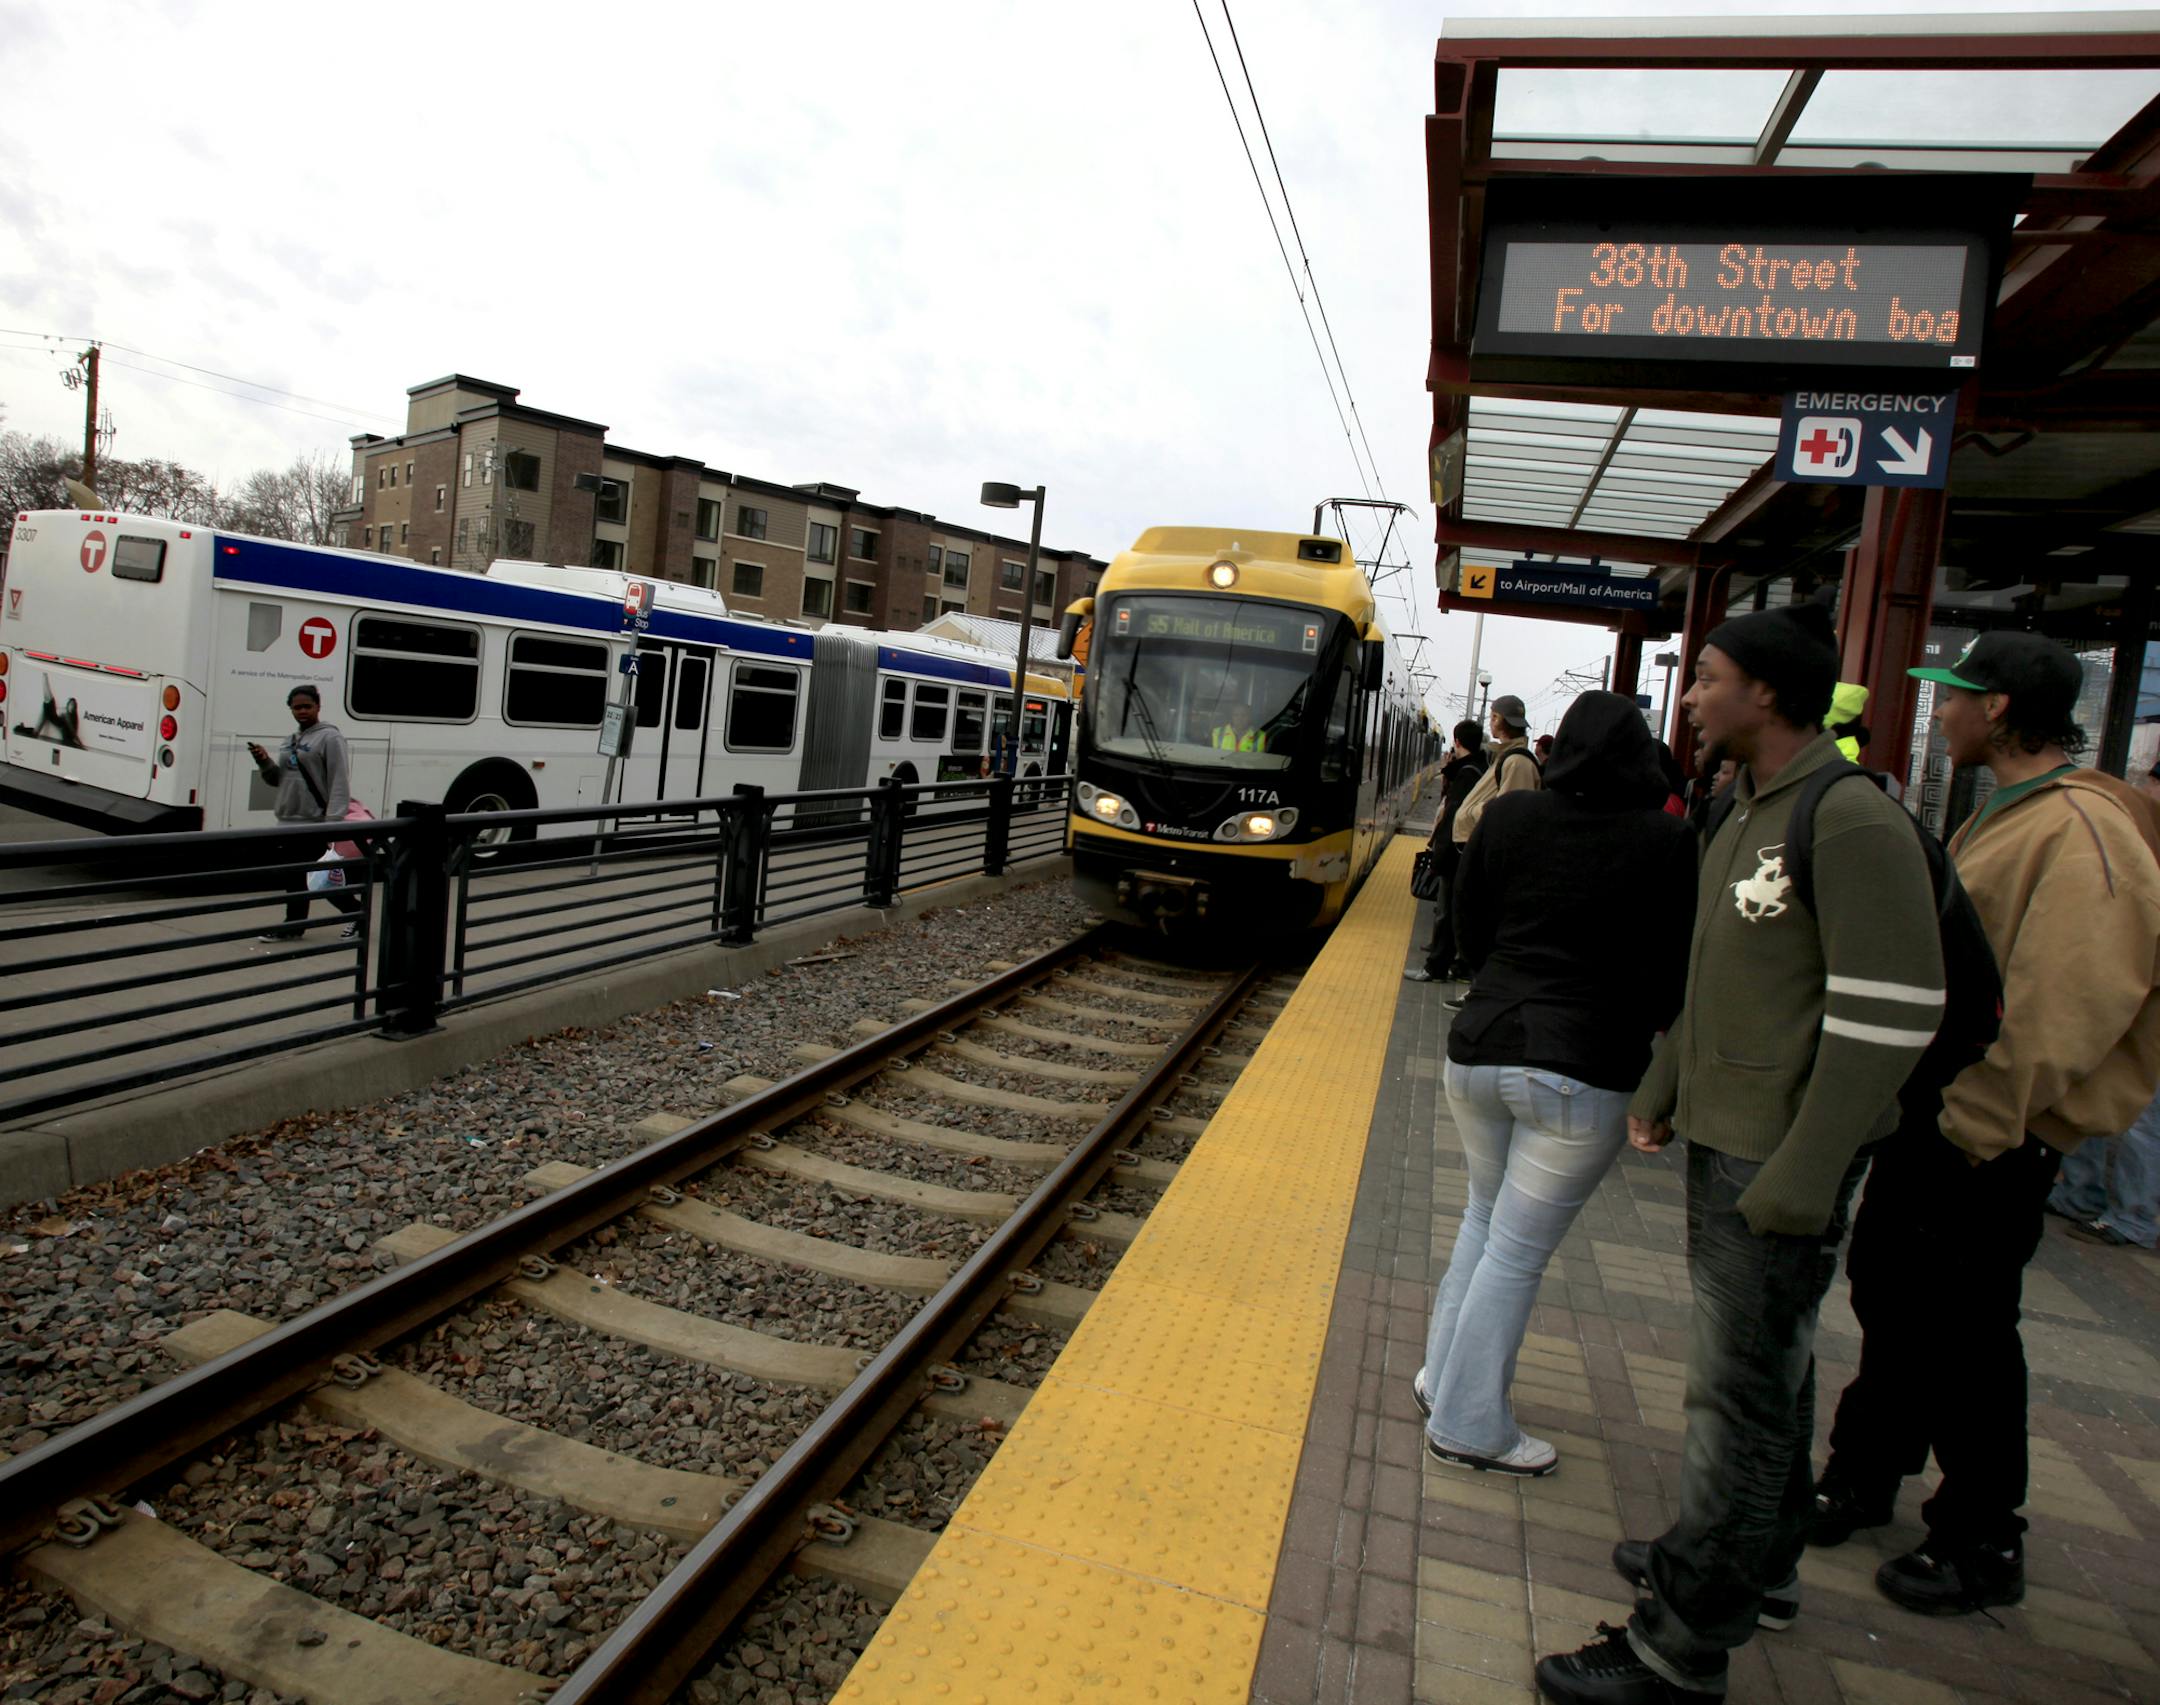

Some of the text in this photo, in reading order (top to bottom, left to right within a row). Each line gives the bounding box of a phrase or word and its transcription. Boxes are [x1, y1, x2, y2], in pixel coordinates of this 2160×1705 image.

[1590, 243, 1861, 291] 38th Street
[1553, 288, 1960, 344] For downtown boa
[1795, 392, 1947, 414] EMERGENCY
[1500, 578, 1653, 600] to Airport/Mall of America
[635, 617, 649, 630] Stop
[637, 608, 649, 619] Bus
[628, 661, 639, 675] A
[83, 711, 144, 731] American Apparel
[1237, 787, 1280, 805] 117A
